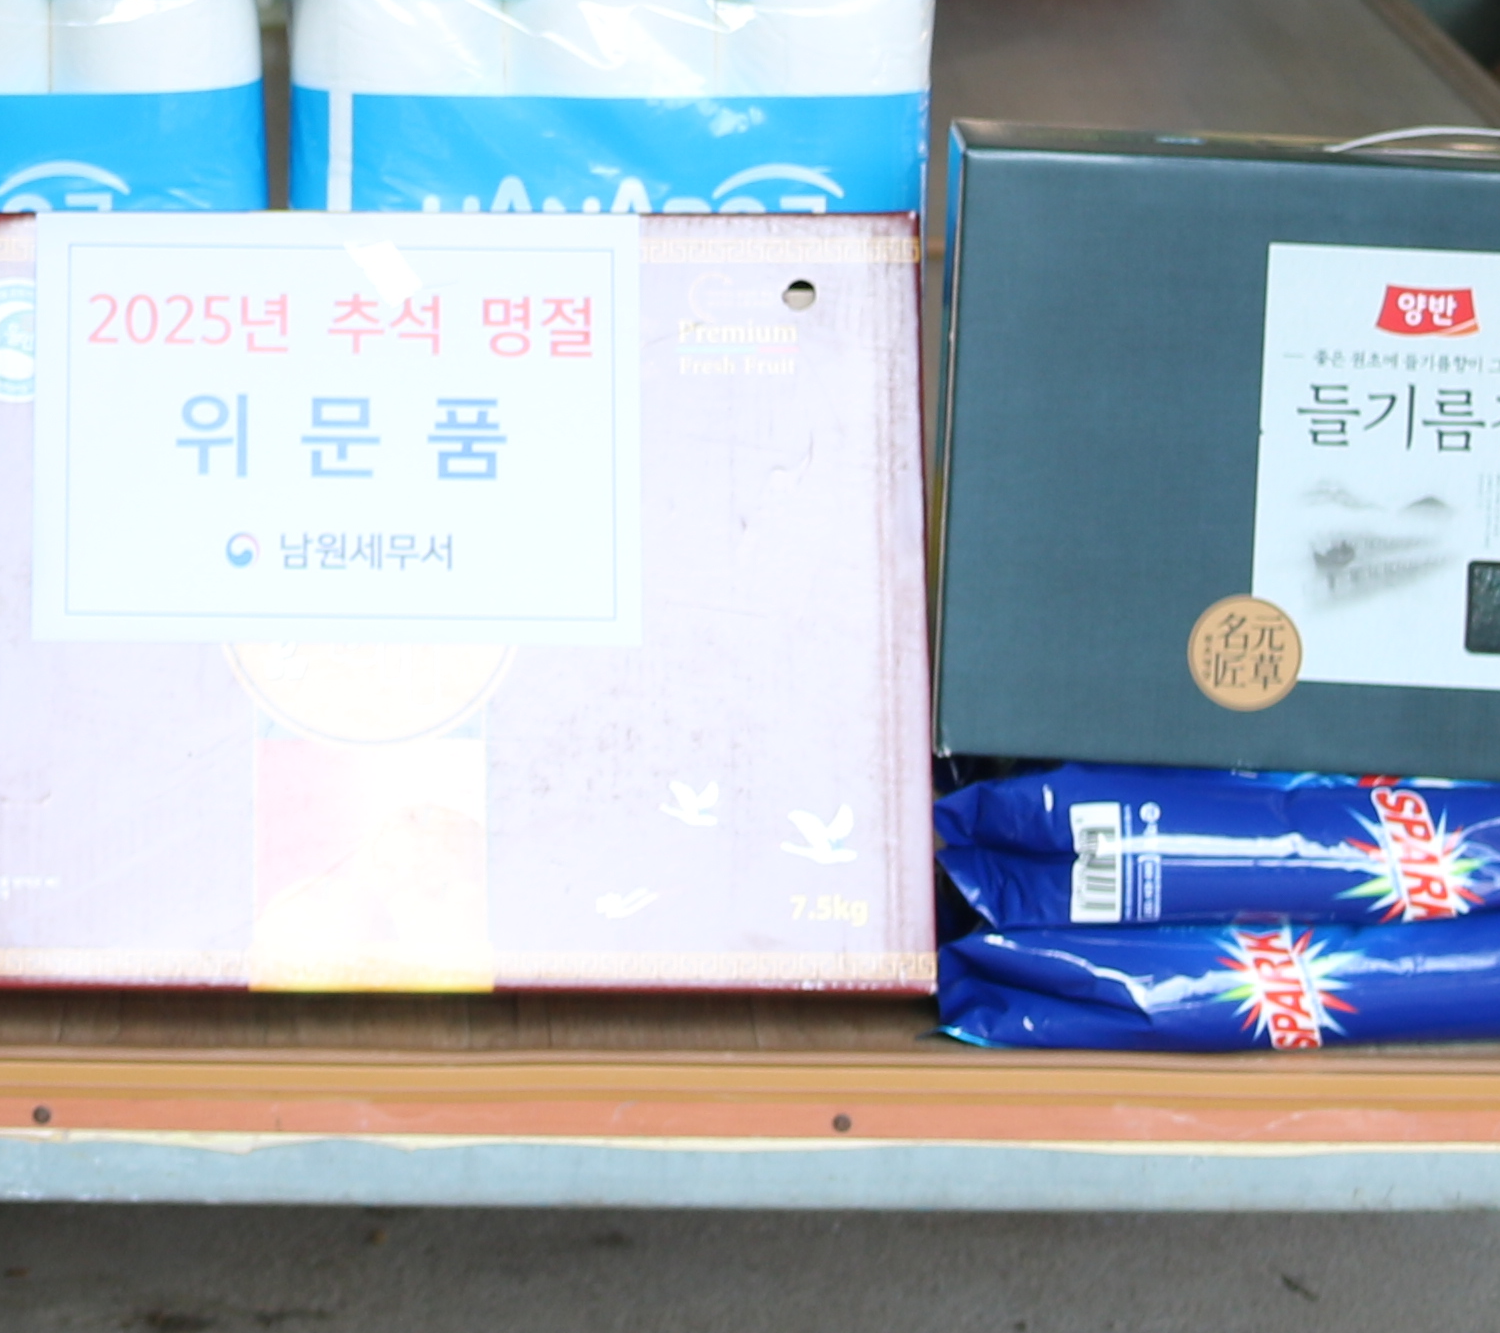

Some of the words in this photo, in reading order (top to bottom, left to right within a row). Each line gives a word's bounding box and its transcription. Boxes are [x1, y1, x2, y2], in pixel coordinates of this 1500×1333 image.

[86, 292, 290, 354] 2025년
[327, 293, 442, 357] 추석
[481, 294, 594, 358] 명절
[1397, 291, 1458, 328] 양반
[678, 318, 798, 344] Premium
[679, 354, 736, 375] Fresh
[744, 354, 796, 375] Fruit
[278, 532, 454, 571] 남원세무서
[788, 892, 869, 927] 7.5kg
[1236, 932, 1320, 1049] SPARK
